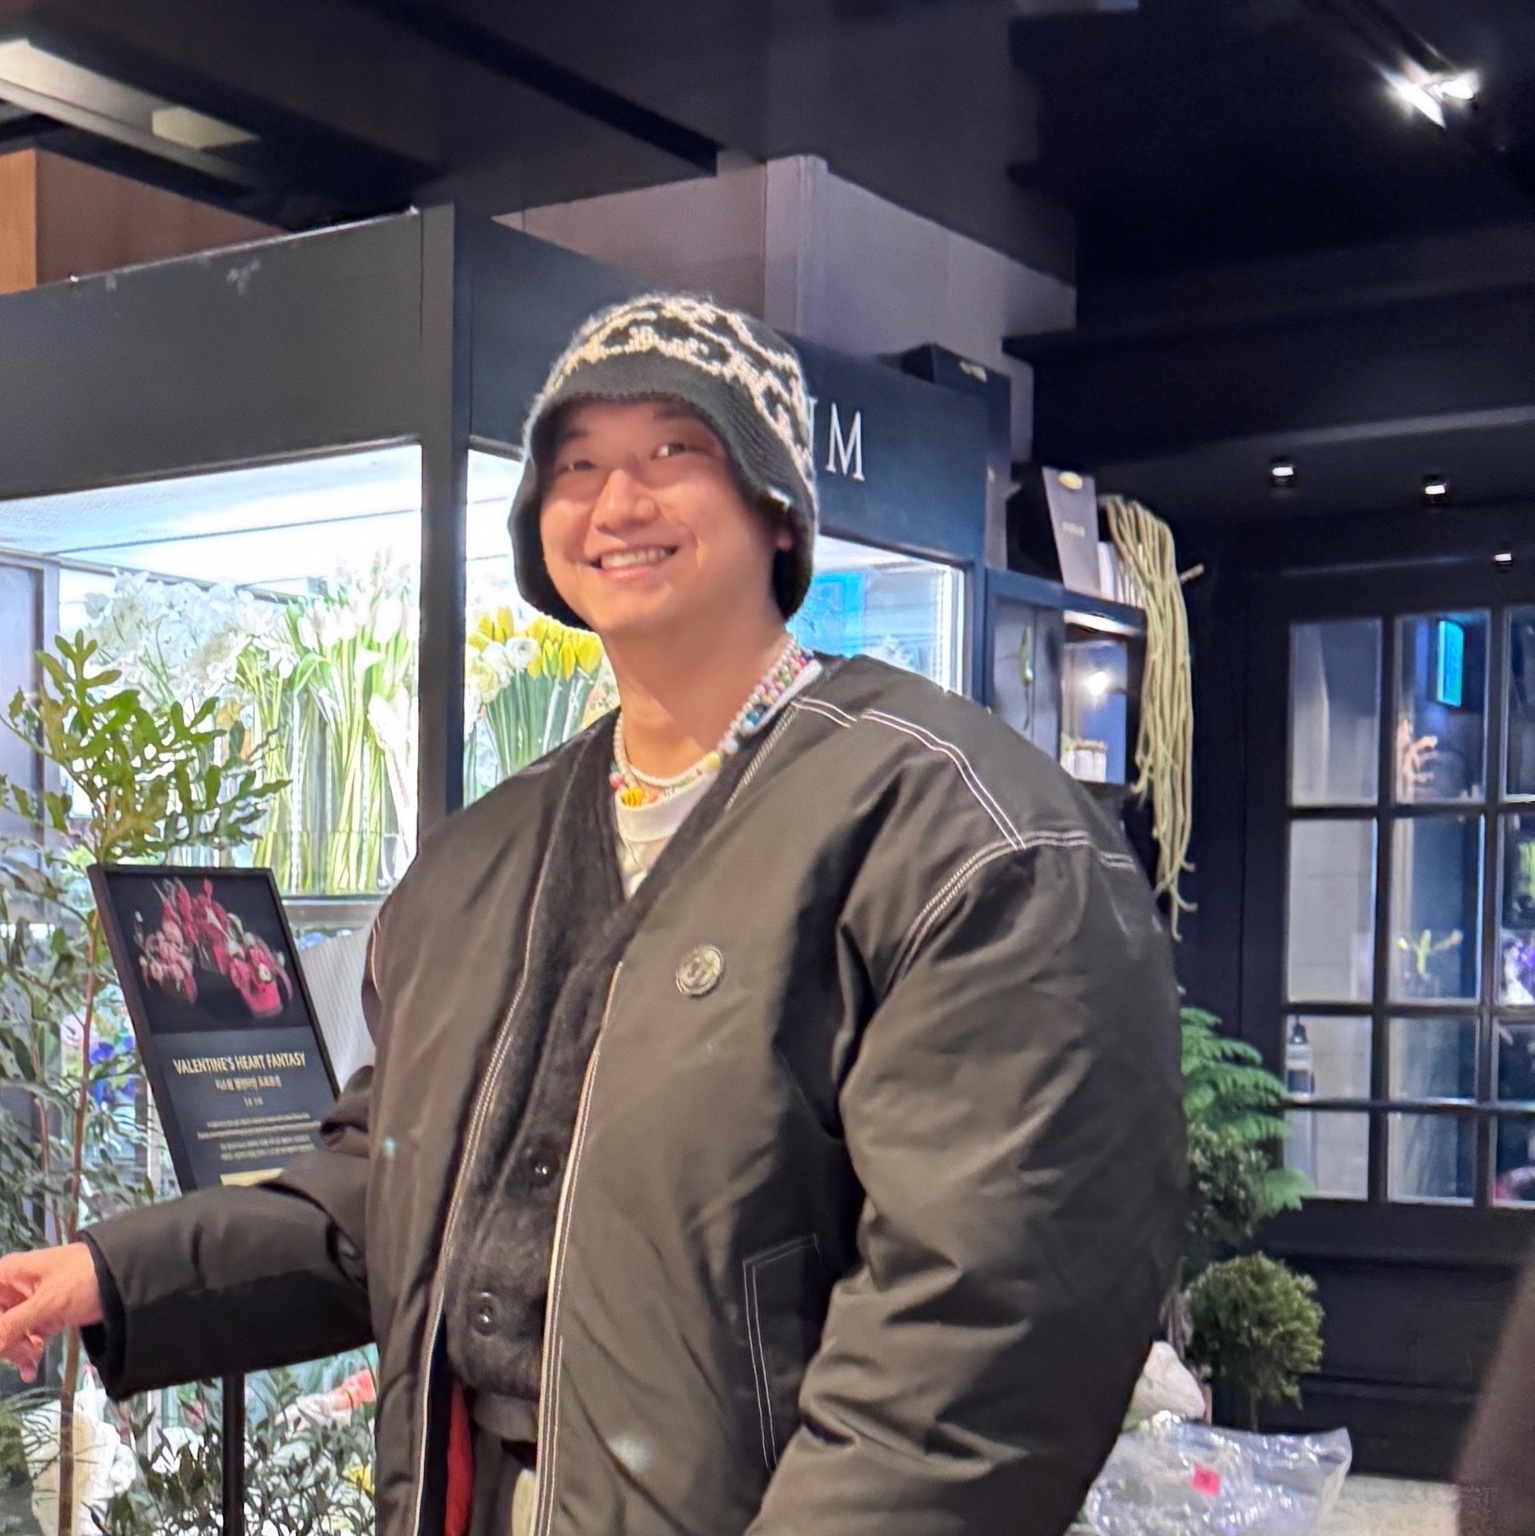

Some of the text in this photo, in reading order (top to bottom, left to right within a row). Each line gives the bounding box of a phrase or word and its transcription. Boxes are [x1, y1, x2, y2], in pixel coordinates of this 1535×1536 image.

[172, 1051, 306, 1075] VALENTINE'S HEART FANTASY
